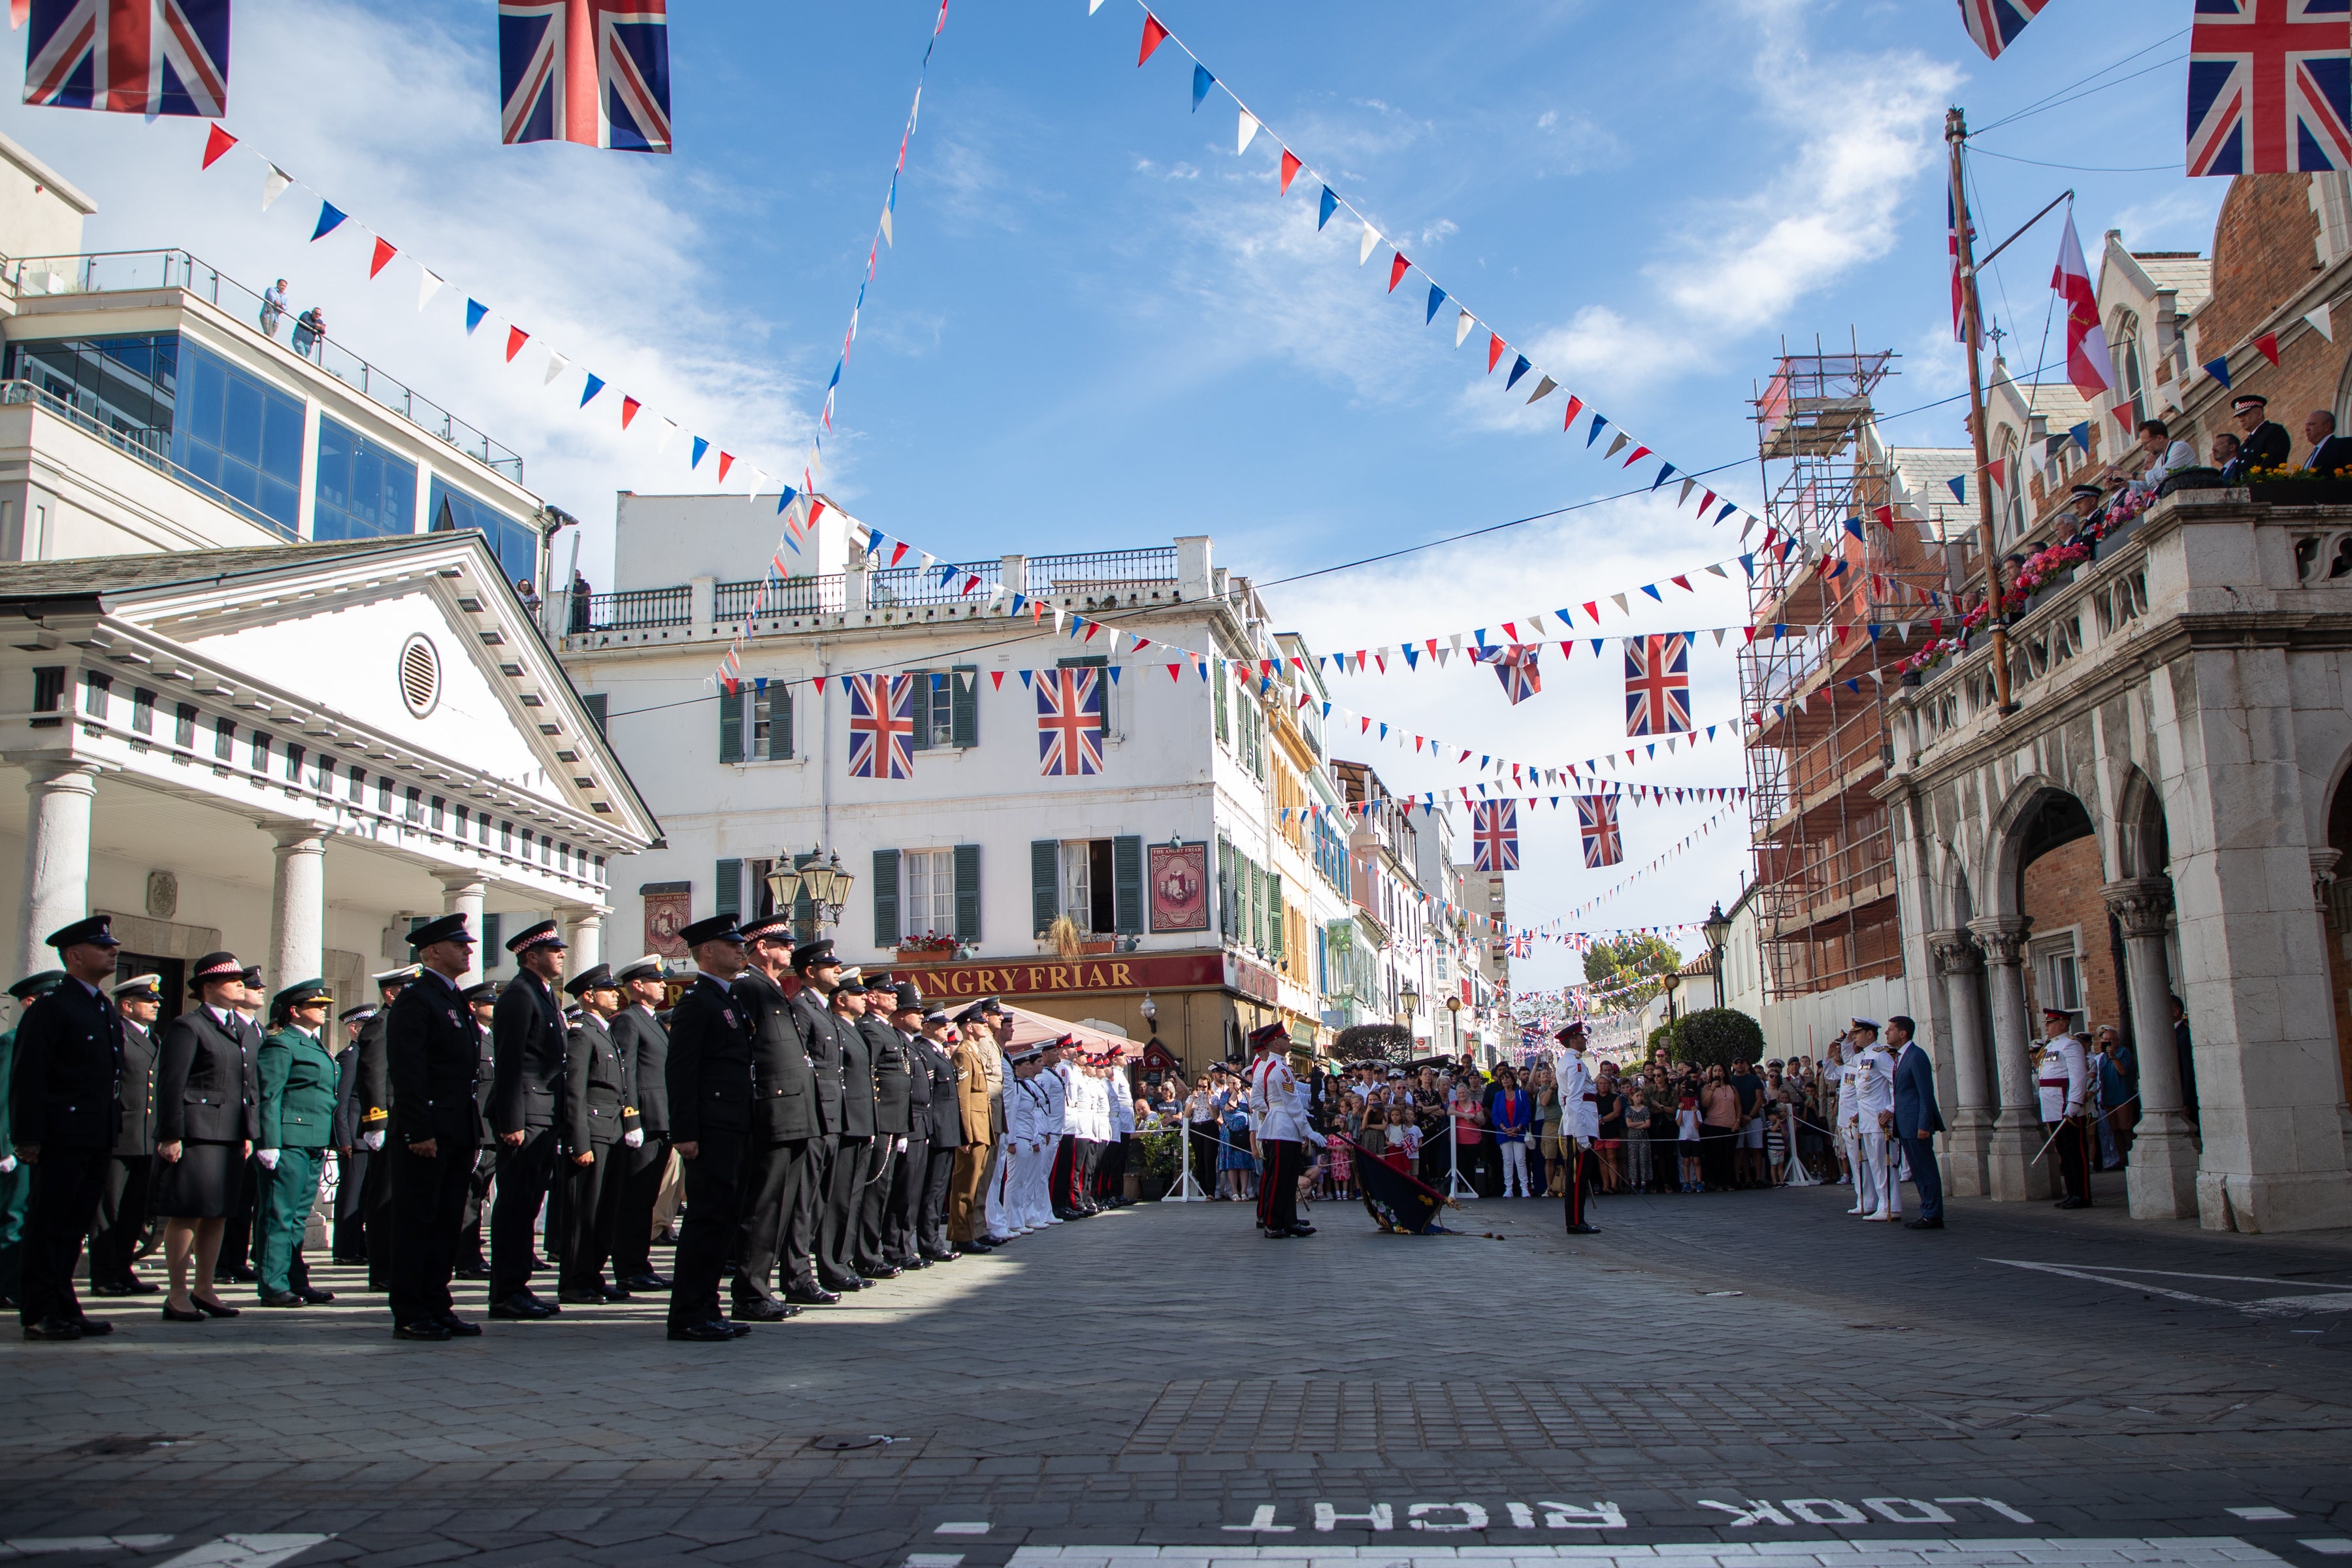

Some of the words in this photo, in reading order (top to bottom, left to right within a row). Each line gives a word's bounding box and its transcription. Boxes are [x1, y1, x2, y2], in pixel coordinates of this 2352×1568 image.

[910, 968, 1019, 995] ANGRY
[1027, 963, 1134, 990] FRIAR
[1220, 1501, 1627, 1531] RIGHT
[1697, 1497, 2034, 1526] LOOK
